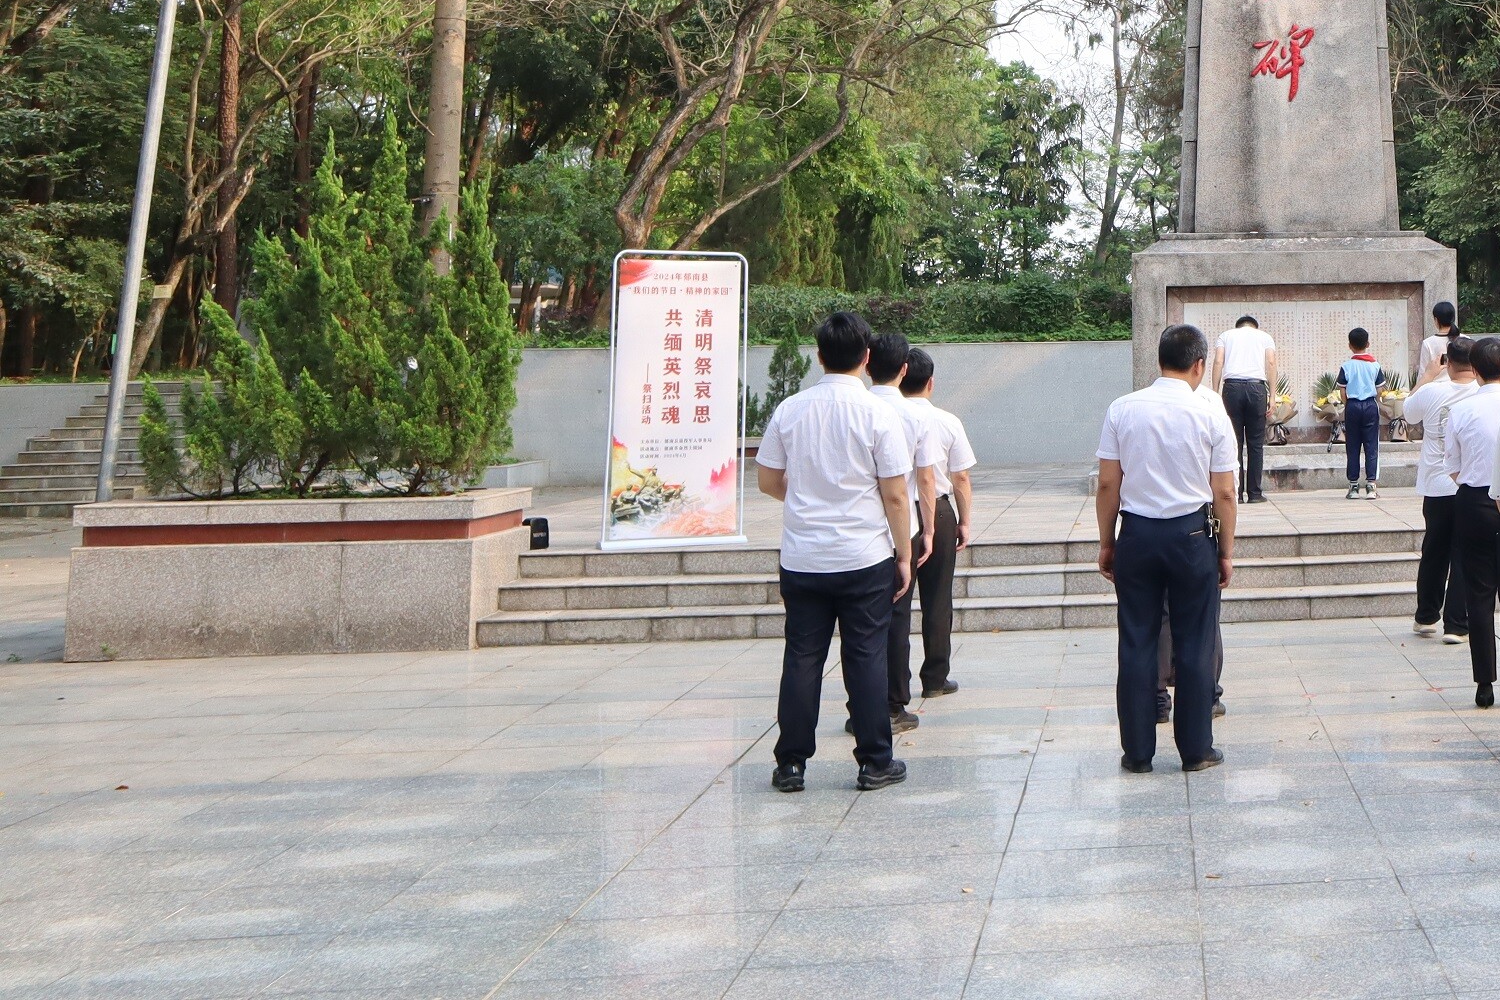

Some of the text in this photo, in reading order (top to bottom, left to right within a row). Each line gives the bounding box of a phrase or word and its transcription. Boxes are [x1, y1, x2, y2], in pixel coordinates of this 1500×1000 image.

[661, 309, 683, 425] 共缅英烈魂
[693, 309, 714, 424] 清明祭哀思
